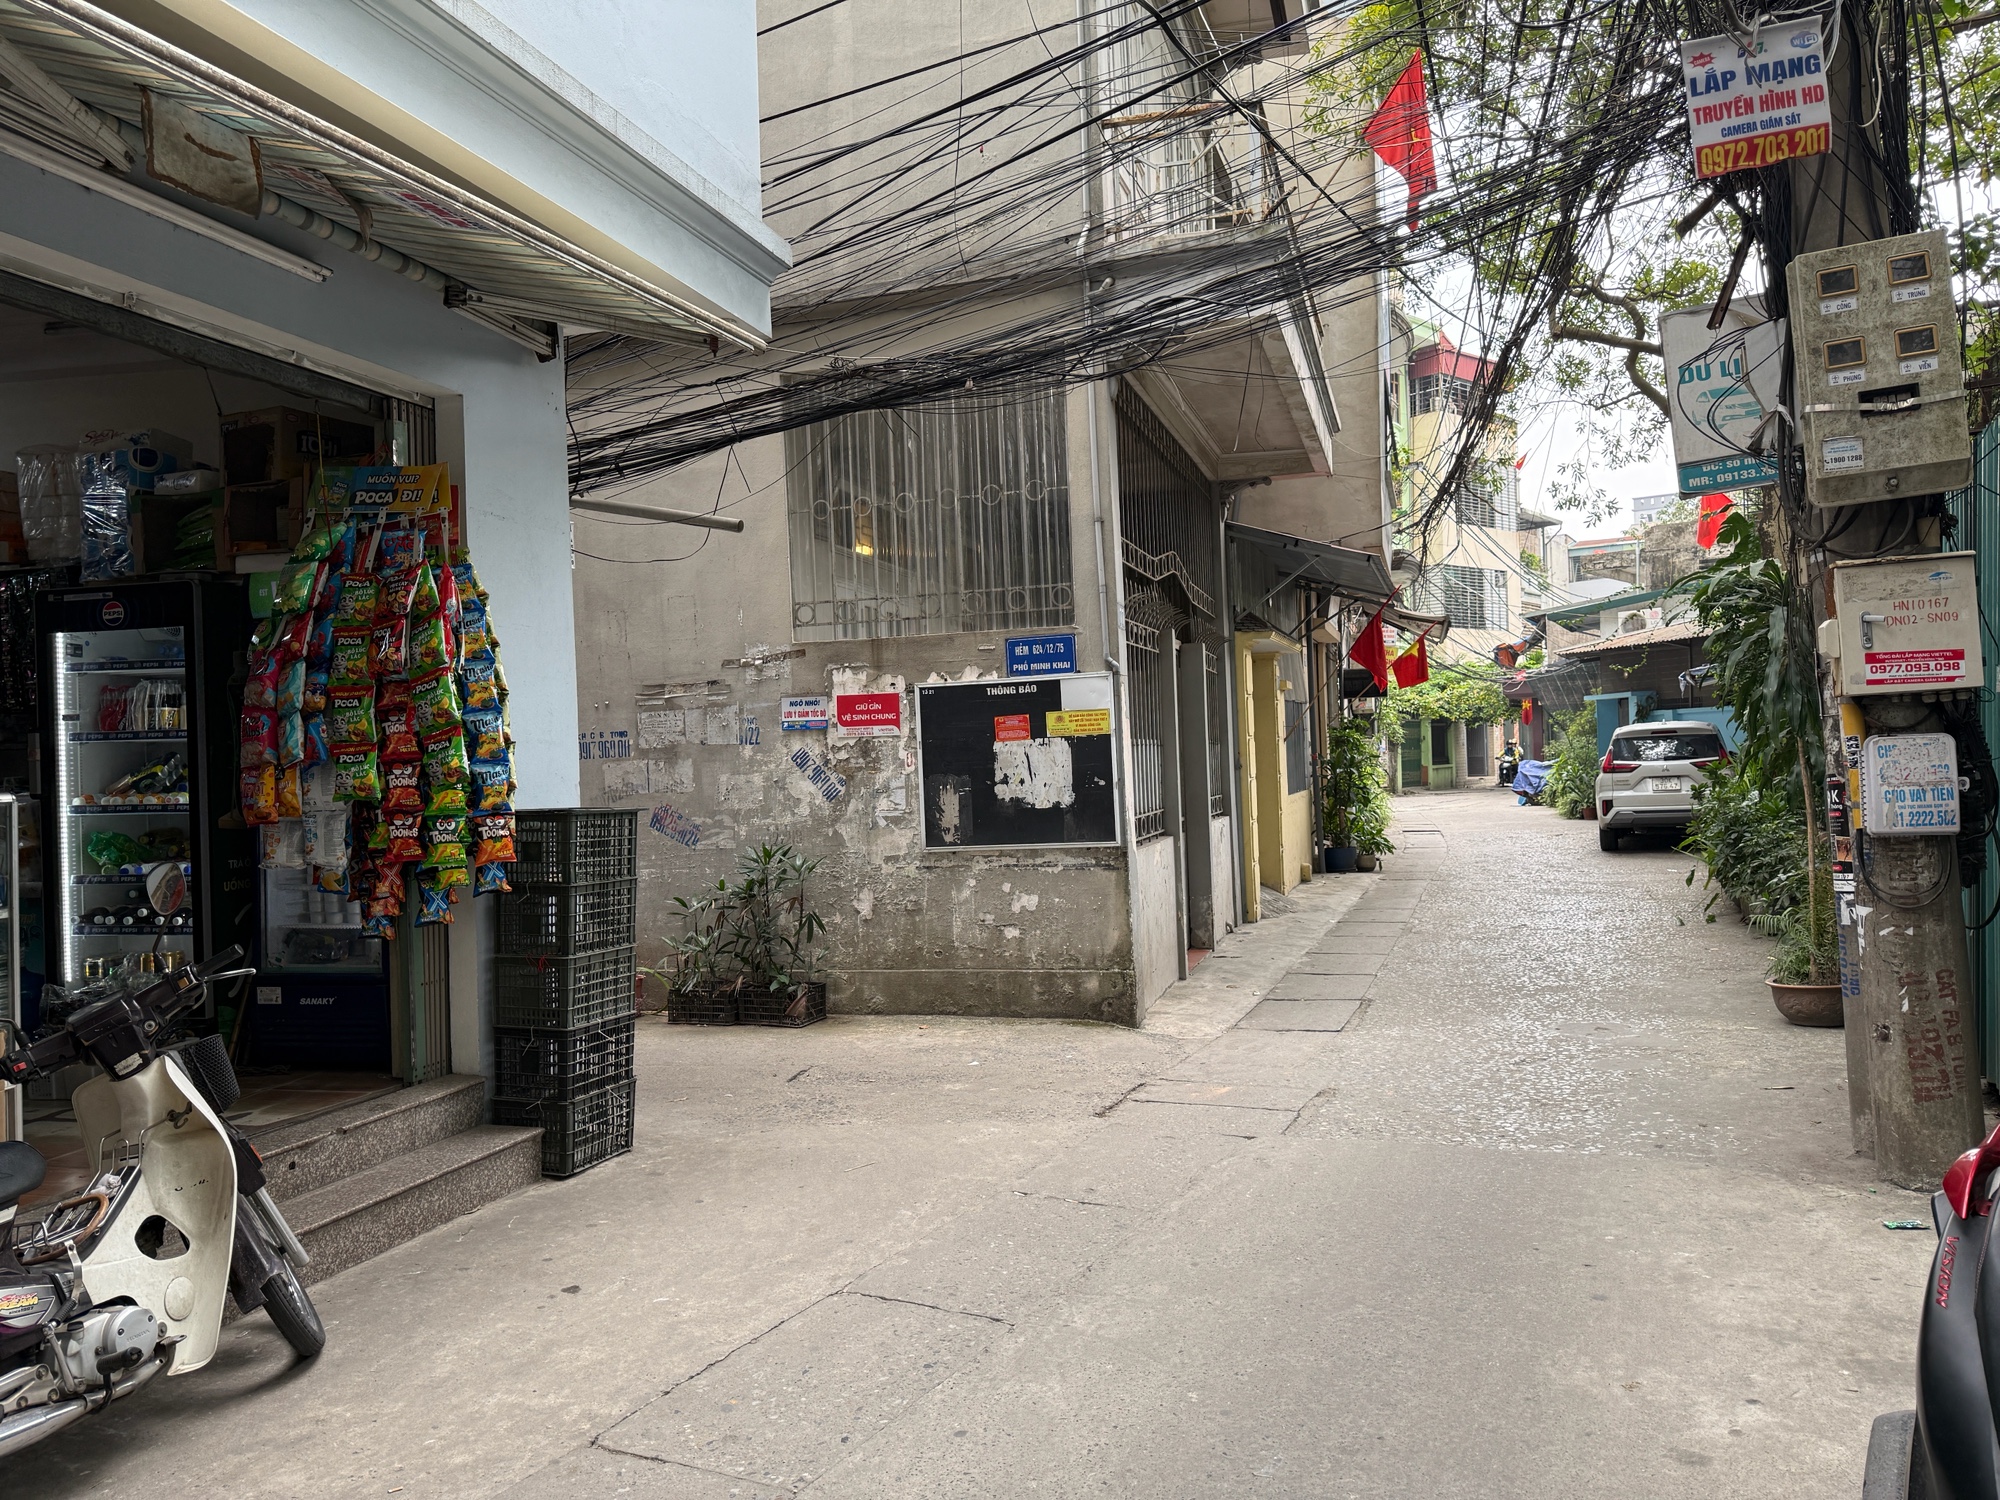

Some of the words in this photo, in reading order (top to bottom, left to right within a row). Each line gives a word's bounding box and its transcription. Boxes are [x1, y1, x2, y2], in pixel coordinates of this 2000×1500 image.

[1690, 67, 1736, 97] LẮP
[1745, 54, 1821, 86] MẠNG
[1693, 94, 1755, 125] TRUYỀN
[1759, 88, 1797, 113] HÌNH
[1802, 84, 1825, 104] HD
[1721, 121, 1758, 138] CAMERA
[1760, 115, 1783, 129] GIÁM
[1785, 112, 1801, 125] SÁT
[1700, 126, 1826, 175] 0972.703.201
[1678, 364, 1711, 385] DU
[367, 472, 396, 484] MUỐN
[399, 474, 420, 484] VUI?
[1689, 475, 1713, 488] MR:
[355, 491, 393, 504] POCA
[401, 490, 421, 503] ĐI!
[103, 609, 123, 618] PEPSI
[337, 637, 362, 646] POCA
[1015, 642, 1030, 656] HẺM
[1033, 643, 1064, 655] 624/12/75
[1013, 660, 1029, 671] PHỐ
[1030, 662, 1050, 671] MINH
[1053, 661, 1070, 669] KHAI
[1869, 661, 1961, 674] 0977.093.098
[416, 680, 438, 693] POCA
[986, 685, 1016, 696] THÔNG
[1018, 683, 1037, 694] BÁO
[334, 698, 360, 708] POCA
[841, 713, 851, 722] VỆ
[852, 712, 869, 721] SINH
[871, 712, 897, 720] CHUNG
[339, 754, 366, 763] POCA
[1909, 787, 1927, 802] VAY
[300, 996, 335, 1005] SANAKY
[1935, 1235, 1960, 1310] VISION
